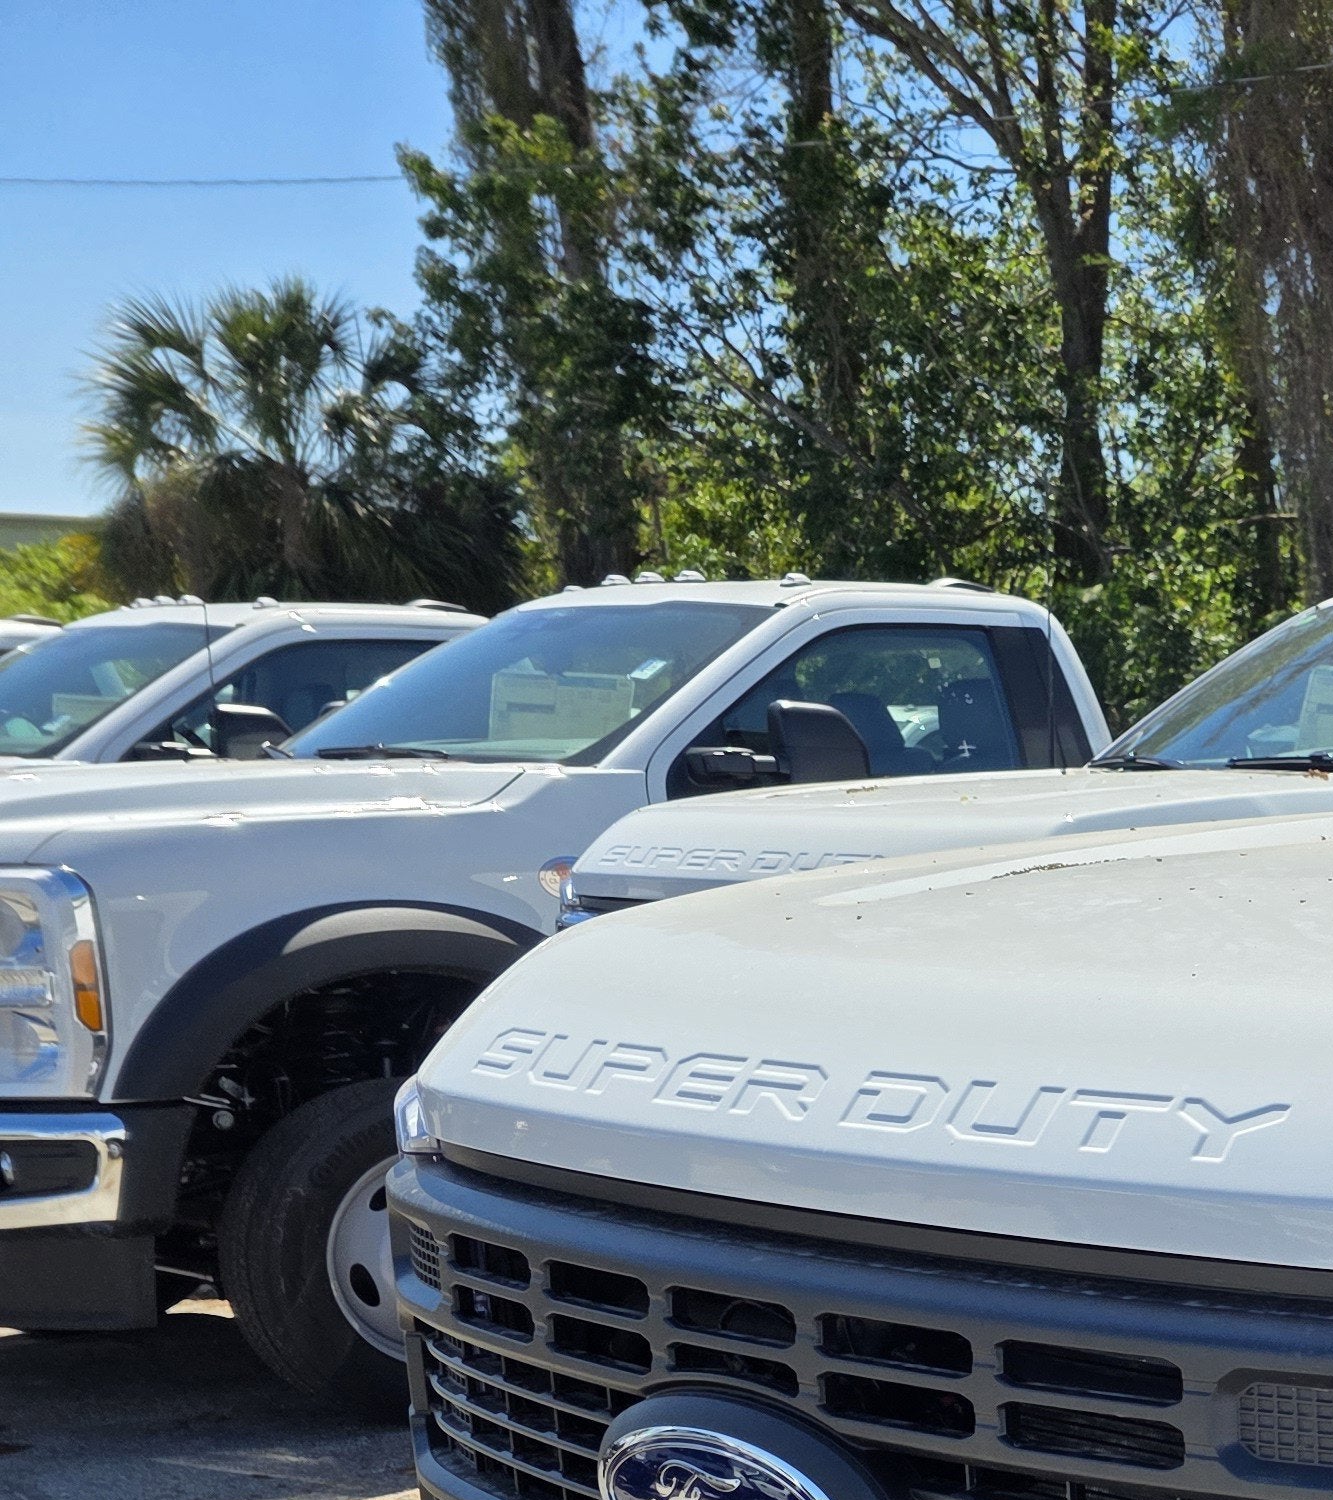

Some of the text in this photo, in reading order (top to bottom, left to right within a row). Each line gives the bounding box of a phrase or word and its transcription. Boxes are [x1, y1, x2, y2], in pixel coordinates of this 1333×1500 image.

[599, 844, 886, 873] SUPER DUT
[471, 1026, 1293, 1163] SUPER DUTY
